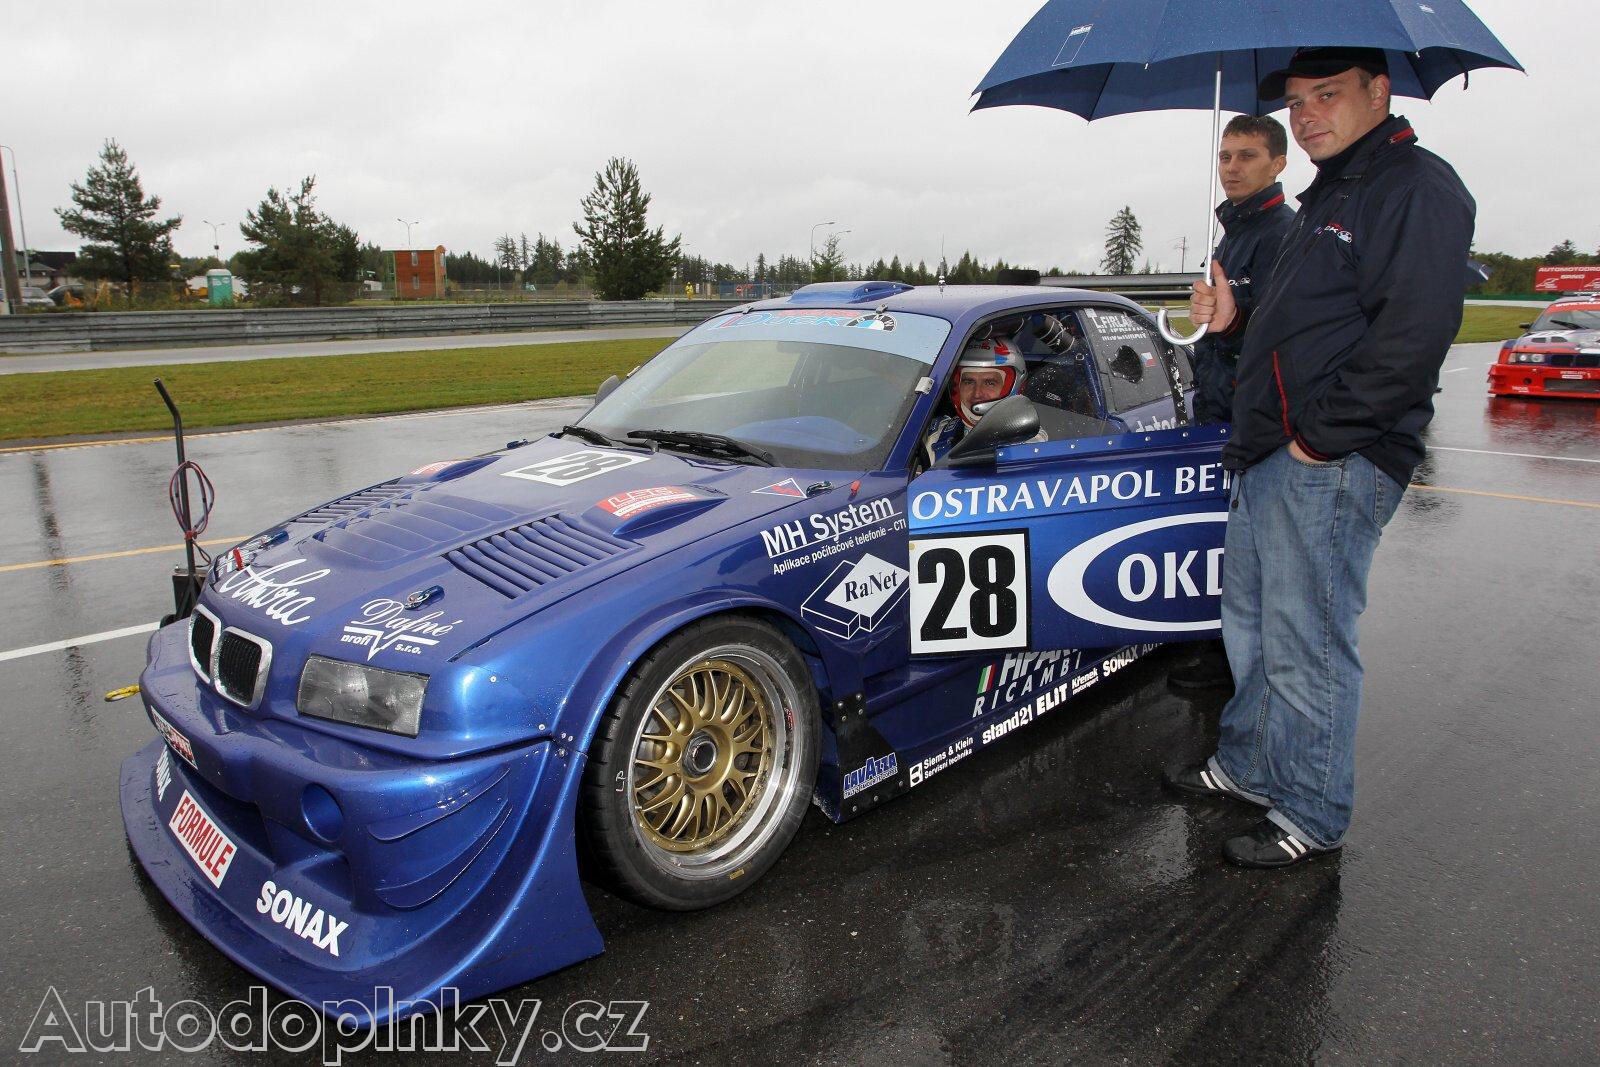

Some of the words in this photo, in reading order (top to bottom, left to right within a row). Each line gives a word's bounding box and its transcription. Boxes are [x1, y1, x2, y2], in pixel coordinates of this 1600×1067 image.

[514, 452, 633, 481] 28
[911, 470, 1161, 520] OSTRAVAPOL
[760, 519, 808, 558] MH
[809, 497, 895, 541] System
[773, 554, 811, 576] Aplikace
[811, 536, 855, 563] počítačové
[855, 526, 887, 546] telefonie
[893, 517, 908, 532] CTI
[844, 569, 898, 602] RaNet
[917, 544, 1018, 642] 28
[340, 633, 374, 646] profi
[394, 643, 422, 655] s.r.o.
[1102, 645, 1139, 677] SONAX
[972, 651, 1082, 718] RICAMBI
[1036, 682, 1069, 716] ELIT
[982, 704, 1033, 745] stand21
[923, 750, 947, 769] Siems
[955, 736, 974, 752] Klein
[172, 795, 234, 879] FORMULE
[256, 880, 349, 957] SONAX
